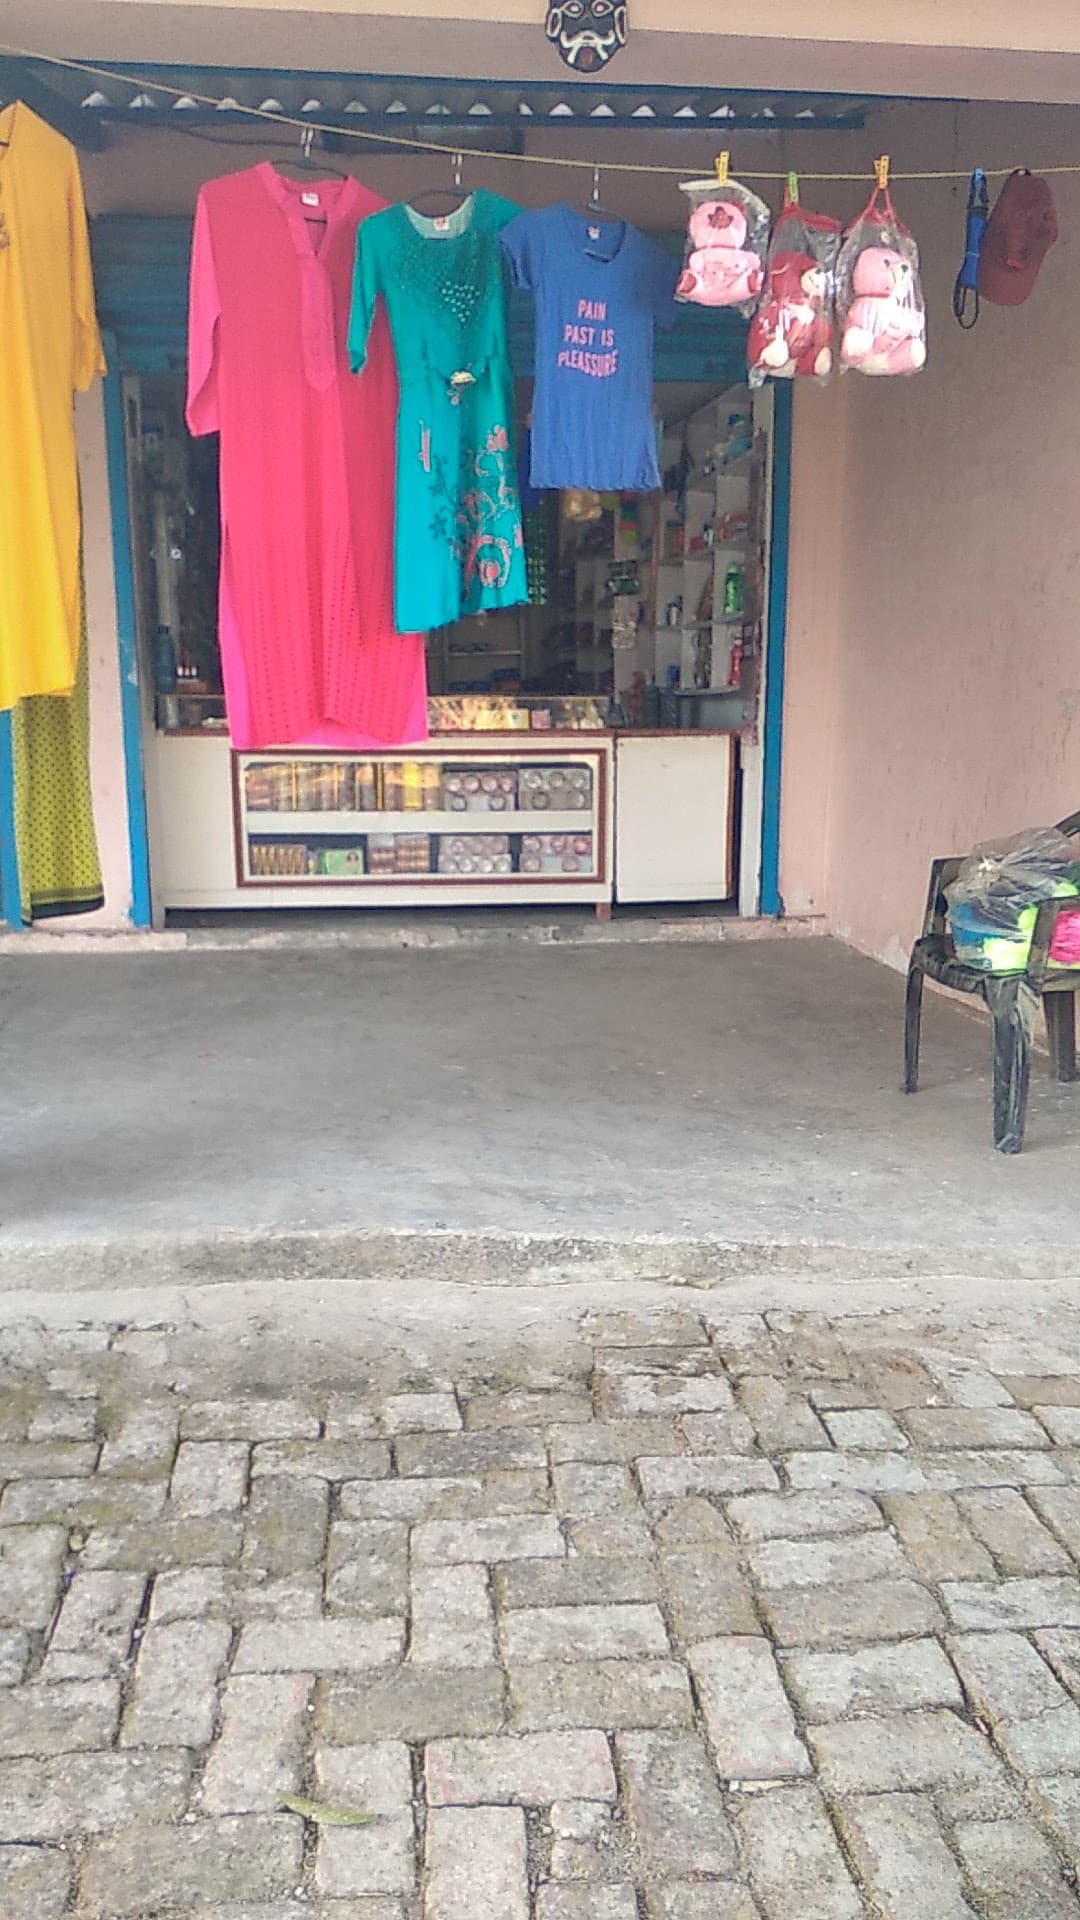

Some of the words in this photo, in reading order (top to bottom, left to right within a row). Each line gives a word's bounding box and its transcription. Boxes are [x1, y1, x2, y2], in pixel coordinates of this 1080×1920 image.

[577, 299, 607, 321] PAIN
[563, 324, 595, 346] PAST
[601, 328, 615, 347] IS
